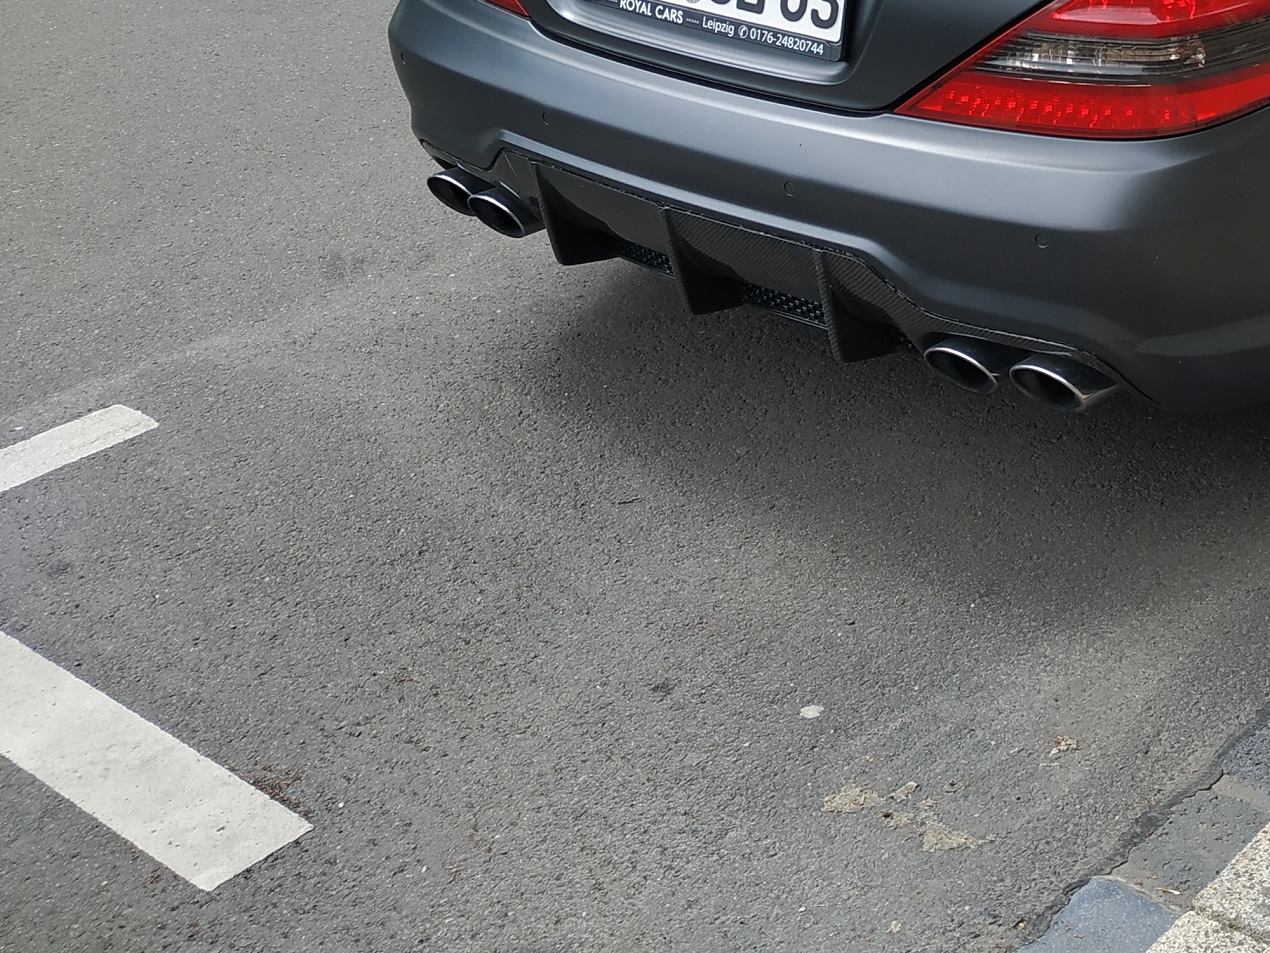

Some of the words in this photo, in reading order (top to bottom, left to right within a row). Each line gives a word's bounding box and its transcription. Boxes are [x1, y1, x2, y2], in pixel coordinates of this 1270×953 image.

[655, 6, 684, 24] CARS
[702, 16, 735, 37] Leipzig
[750, 29, 824, 55] 0176-24820744
